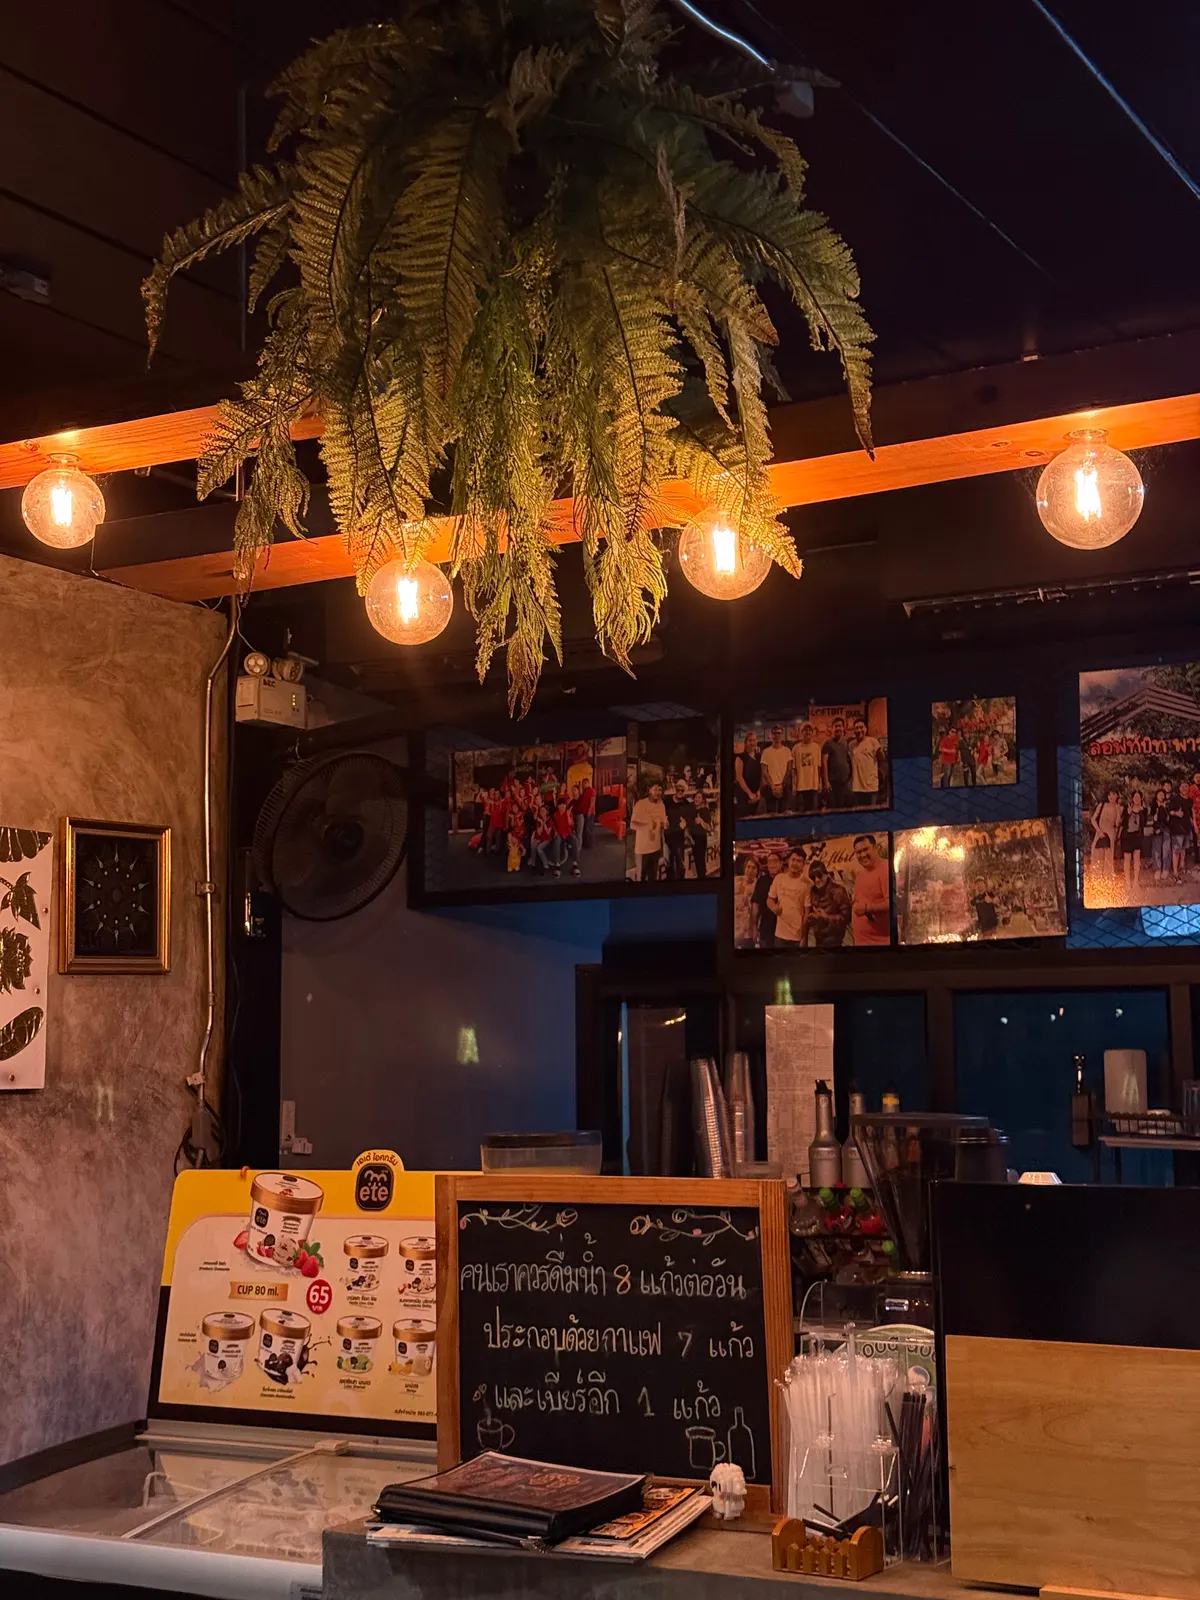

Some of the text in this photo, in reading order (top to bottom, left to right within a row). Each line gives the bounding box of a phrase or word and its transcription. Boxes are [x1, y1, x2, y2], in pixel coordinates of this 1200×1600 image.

[460, 1233, 747, 1299] คนเราควรดื่มน้ำ 8 แก้วต่อวัน
[237, 1285, 279, 1296] CUP 80 ml.
[309, 1284, 330, 1304] 65
[483, 1306, 754, 1360] ประกอบด้วยกาแฟ 7 แก้ว
[637, 1386, 656, 1418] 1
[673, 1380, 721, 1421] แก้ว
